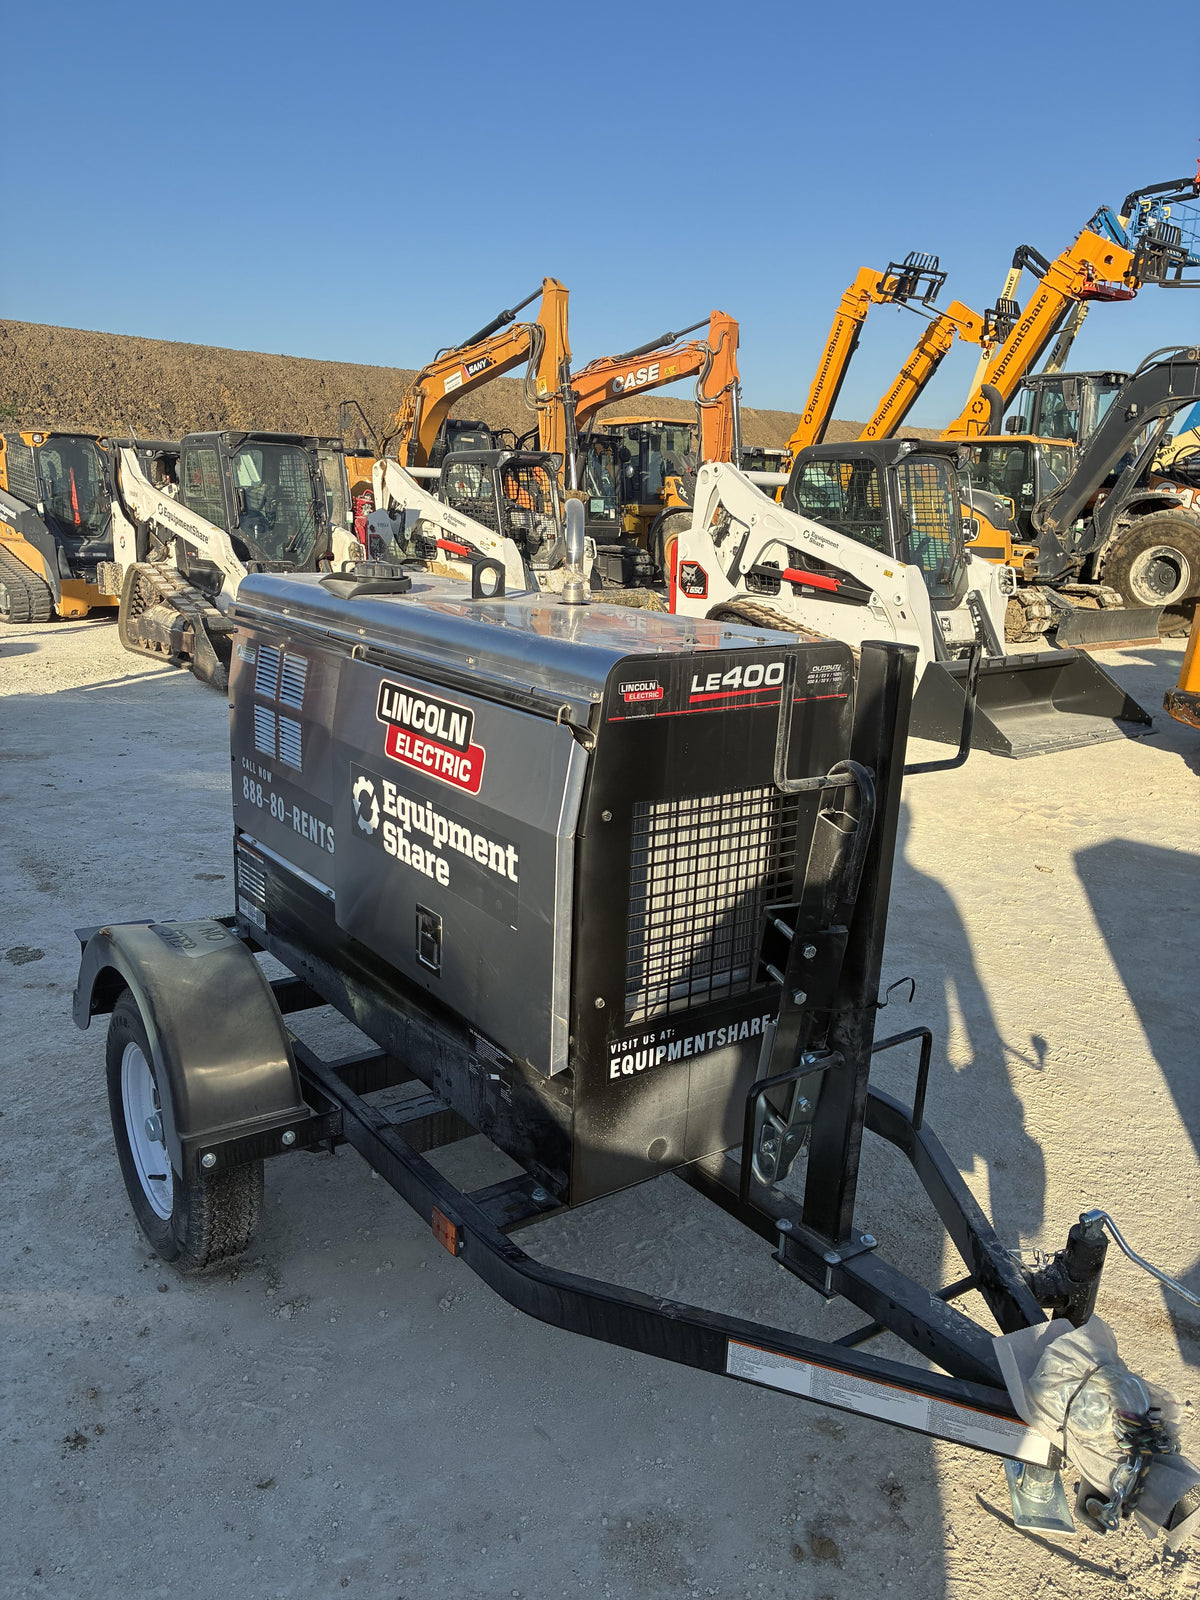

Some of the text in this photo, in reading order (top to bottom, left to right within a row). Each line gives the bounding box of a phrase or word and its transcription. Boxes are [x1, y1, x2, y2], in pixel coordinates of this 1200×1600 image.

[980, 294, 1049, 400] uipmentShare
[1051, 343, 1062, 361] JLG
[468, 358, 487, 378] SANY
[612, 363, 660, 393] CASE
[808, 319, 845, 413] EquipmentShare
[163, 506, 210, 545] EquipmentShare
[810, 530, 839, 549] Equipment
[809, 536, 825, 549] Share
[620, 681, 656, 693] LINCOLN
[691, 662, 785, 693] LE400
[629, 690, 660, 700] ELECTRIC
[381, 688, 468, 746] LINCOLN
[242, 756, 273, 784] CALL NOW
[395, 732, 472, 783] ELECTRIC
[242, 775, 335, 855] 888-80-RENTS
[382, 779, 519, 883] Equipment
[383, 820, 450, 887] Share
[199, 926, 227, 941] NO
[610, 1028, 676, 1054] VISIT US AT:
